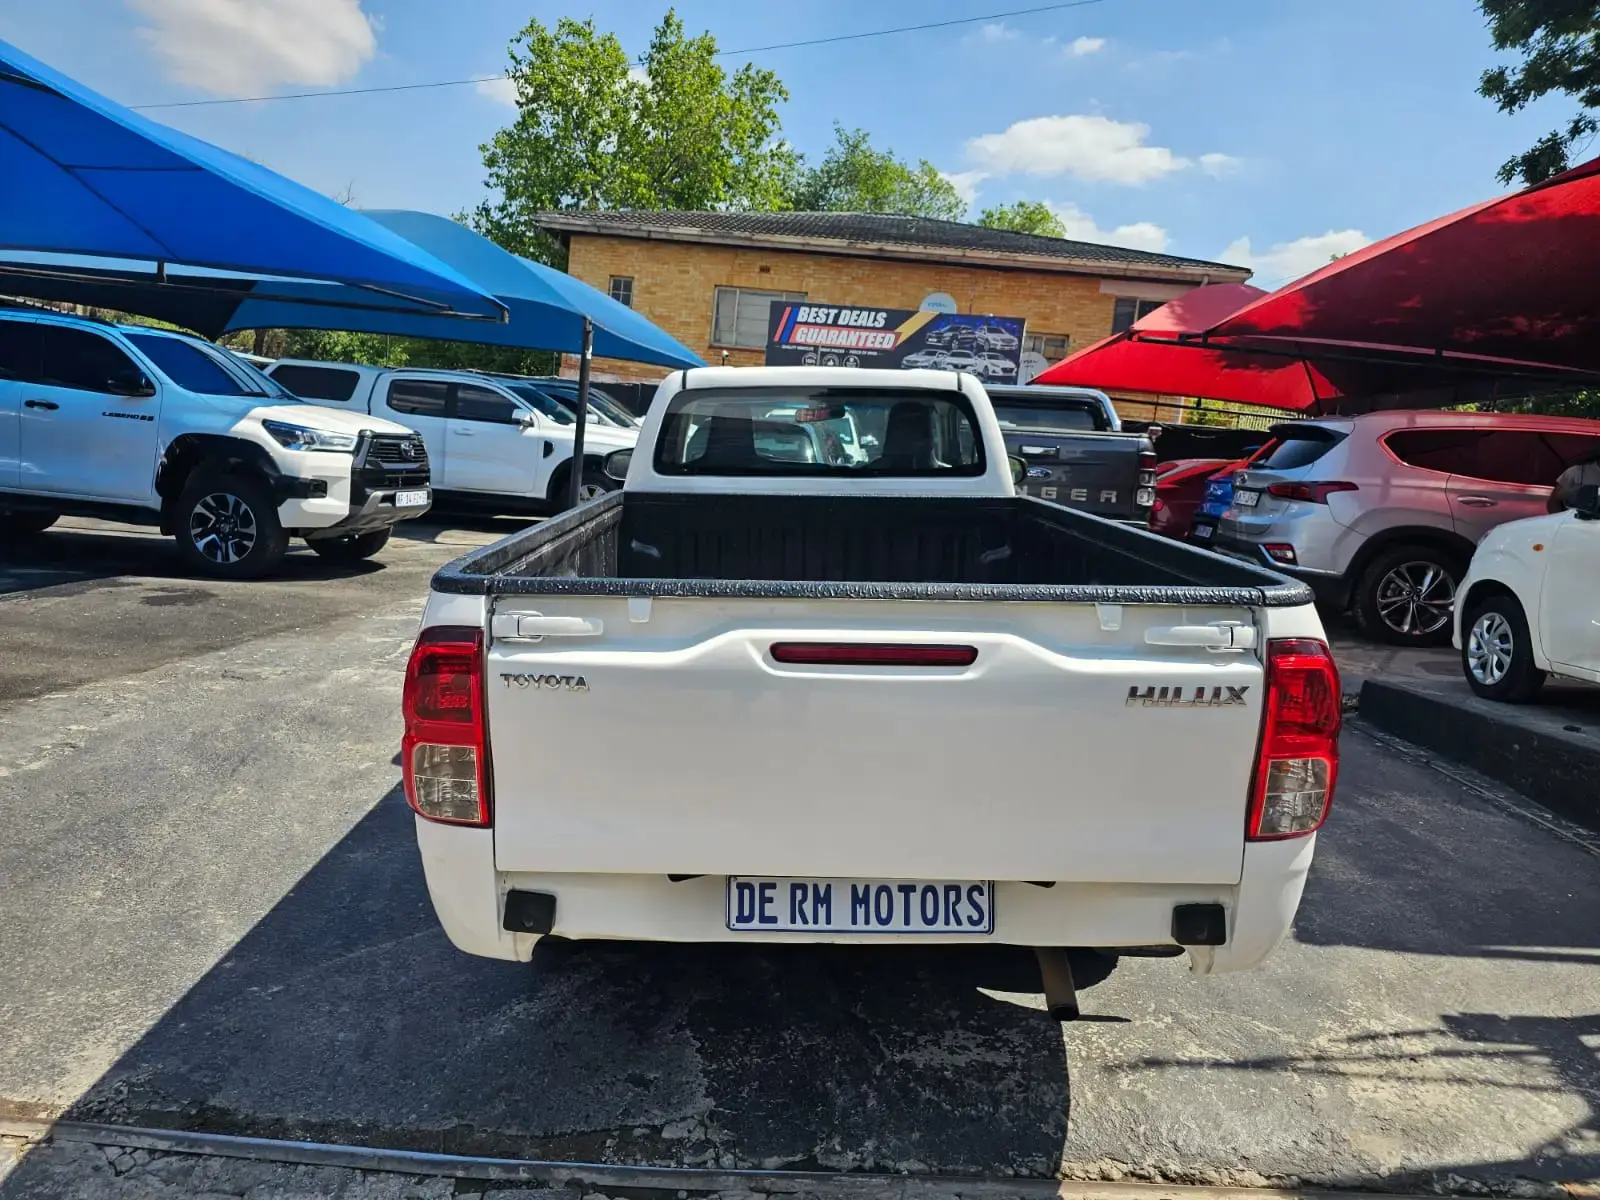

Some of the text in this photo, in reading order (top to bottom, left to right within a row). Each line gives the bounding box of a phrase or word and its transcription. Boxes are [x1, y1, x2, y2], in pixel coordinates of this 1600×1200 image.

[796, 306, 888, 328] BEST DEALS
[795, 327, 896, 349] GUARANTEED
[1014, 485, 1117, 504] NGER
[500, 673, 590, 692] TOYOTA
[1125, 685, 1250, 707] HILUX
[735, 882, 985, 927] DE RM MOTORS
